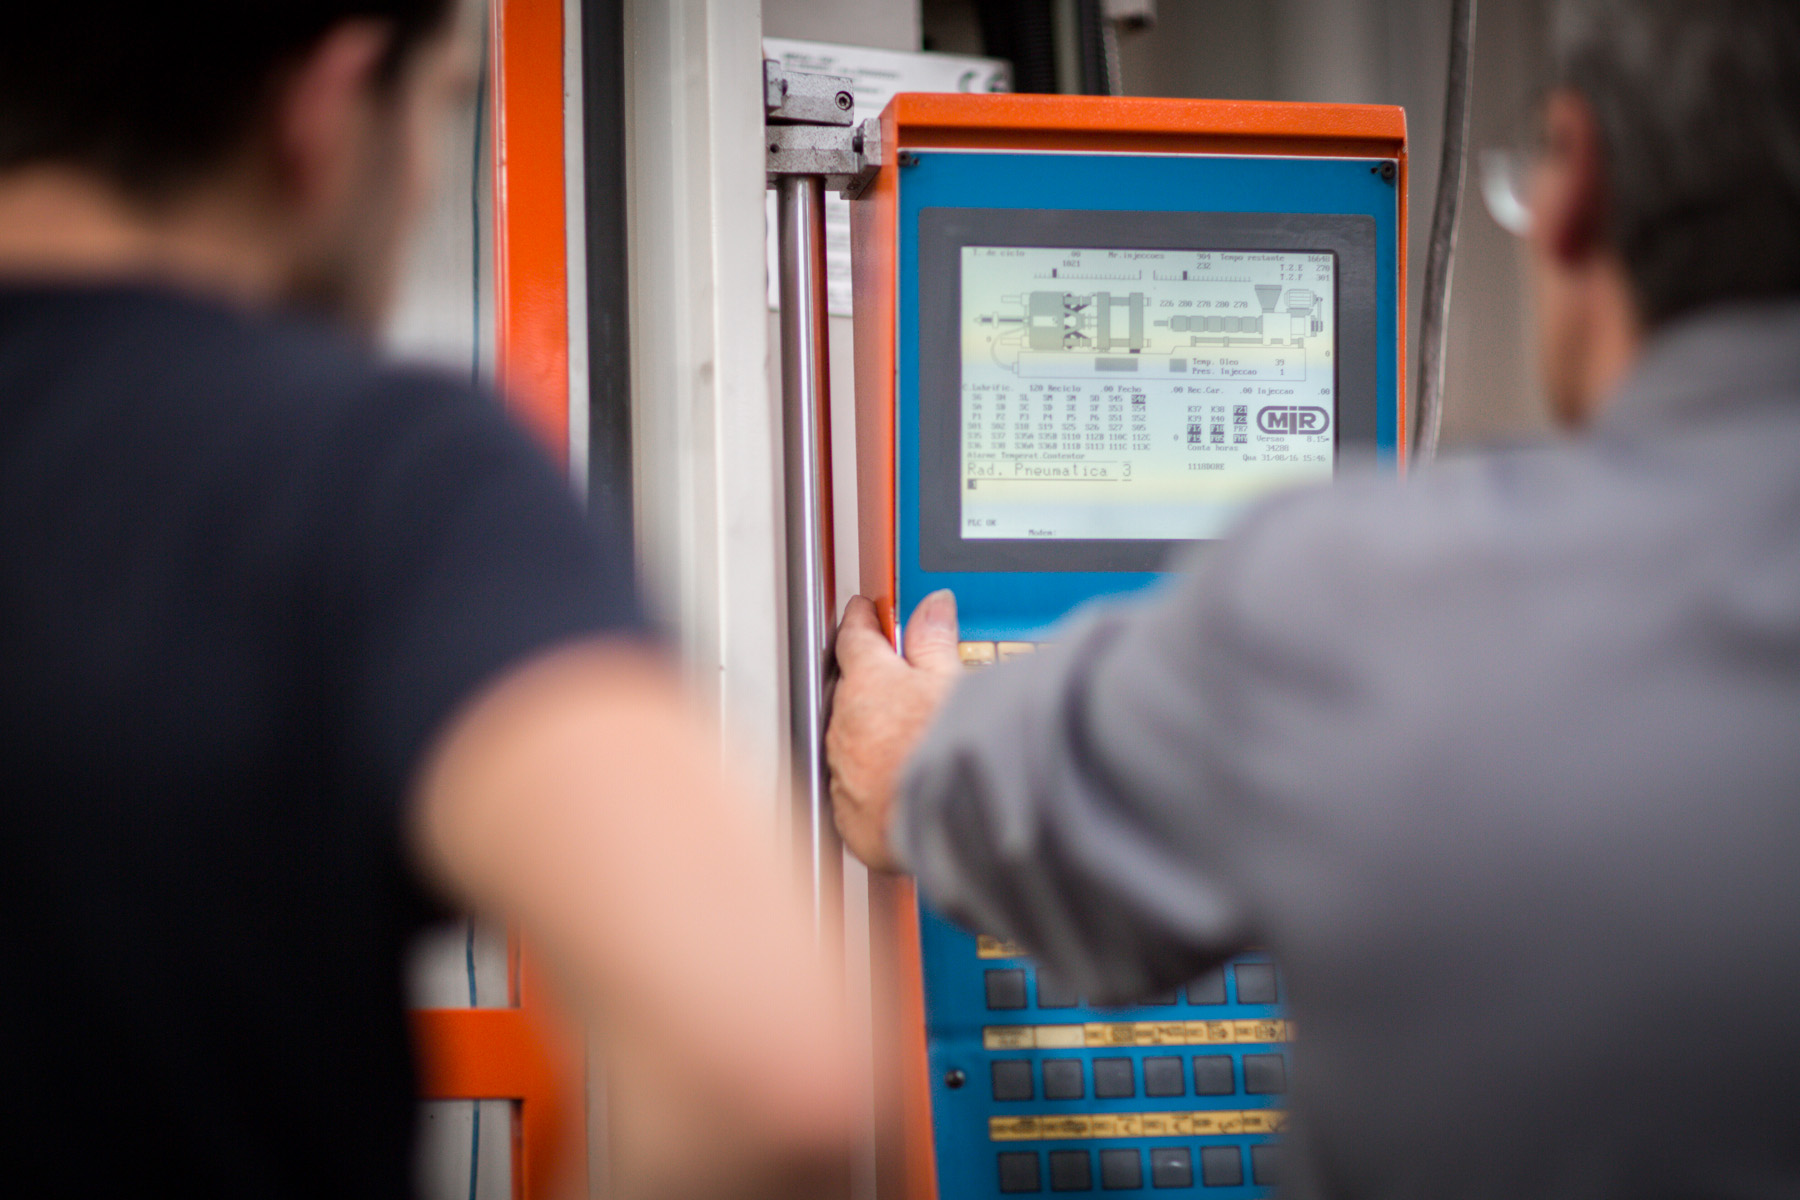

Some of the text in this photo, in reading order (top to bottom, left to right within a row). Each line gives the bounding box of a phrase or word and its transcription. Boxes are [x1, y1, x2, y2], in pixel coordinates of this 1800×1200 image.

[1000, 249, 1025, 257] ciclo
[1220, 253, 1244, 262] Tempo
[1247, 254, 1285, 262] restante
[1062, 259, 1081, 268] 1021
[1196, 261, 1211, 270] 232
[1315, 264, 1330, 272] 270
[1159, 299, 1174, 308] 226
[1196, 300, 1211, 308] 278
[1233, 300, 1248, 309] 278
[1192, 358, 1285, 367] Temp. Oleo 39
[1192, 367, 1215, 376] Pres.
[1220, 367, 1258, 378] Injeccao
[1029, 384, 1043, 392] 120
[1047, 384, 1082, 393] Reciclo
[1118, 385, 1142, 393] Fecho
[1187, 386, 1224, 395] Rec.Car.
[1257, 387, 1294, 397] Injeccao
[1187, 405, 1202, 413] K37
[972, 413, 982, 421] P1
[1019, 413, 1029, 421] P3
[1042, 413, 1053, 421] P4
[1066, 413, 1077, 421] P5
[1187, 415, 1202, 423] K39
[1210, 415, 1225, 423] K40
[1268, 412, 1317, 435] MIR
[1257, 435, 1285, 443] Versao
[1187, 444, 1239, 452] Conta horas
[1242, 454, 1326, 463] Qua 31/08/16 15:46
[967, 463, 1132, 477] Rad. Pneumatica 3
